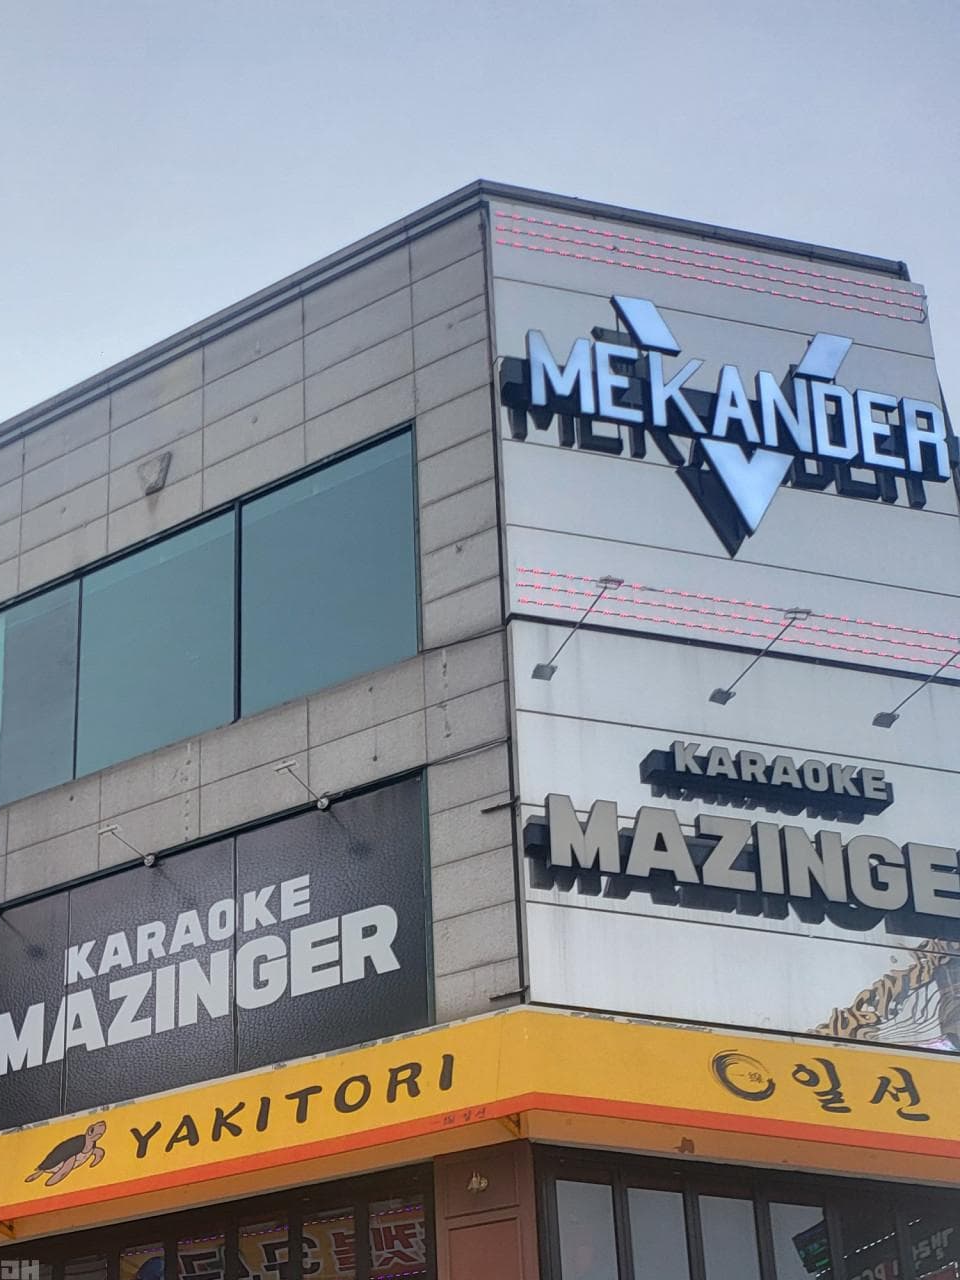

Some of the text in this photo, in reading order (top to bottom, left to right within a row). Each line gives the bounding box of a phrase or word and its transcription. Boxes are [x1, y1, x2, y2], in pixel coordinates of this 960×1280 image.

[525, 322, 951, 485] MEKANDER
[670, 741, 889, 801] KARAOKE
[544, 793, 960, 920] MAZINGE
[64, 874, 311, 986] KARAOKE
[131, 1054, 454, 1159] YAKITORI
